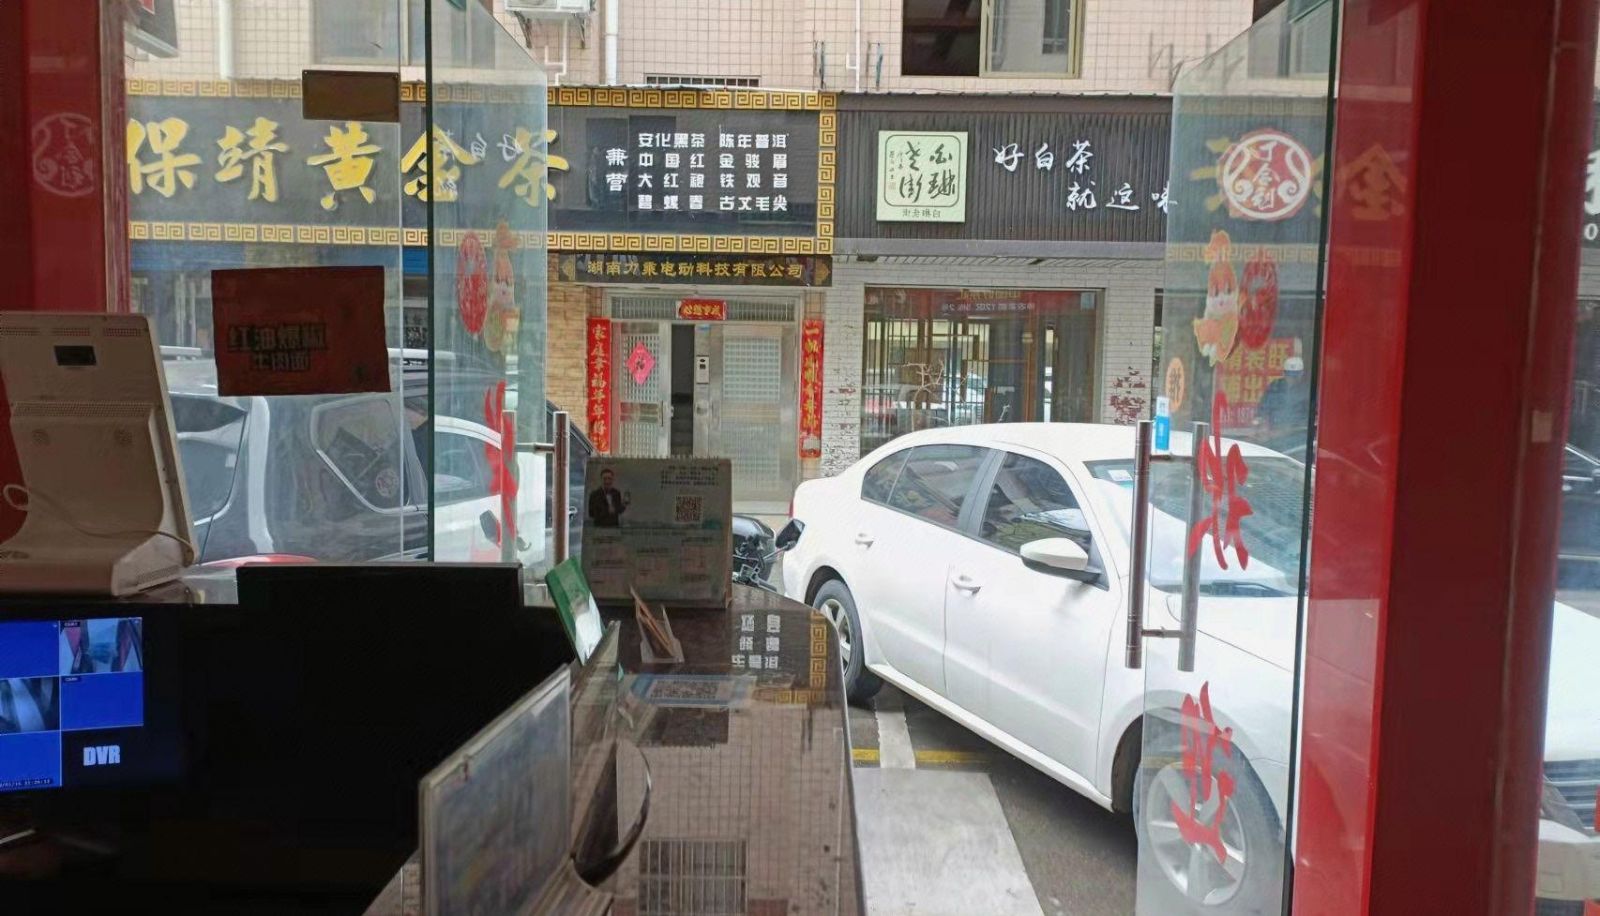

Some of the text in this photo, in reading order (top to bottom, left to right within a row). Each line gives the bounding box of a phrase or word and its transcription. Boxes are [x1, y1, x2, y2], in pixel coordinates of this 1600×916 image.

[638, 133, 787, 149] 安化黑茶 陈年普洱
[126, 116, 569, 210] 保靖黄金茶
[638, 153, 788, 169] 中国红 金骏眉
[993, 139, 1094, 175] 好白茶
[638, 173, 788, 188] 大红袍 铁观音
[638, 194, 788, 211] 碧螺春 古丈毛尖
[83, 745, 120, 766] DVR
